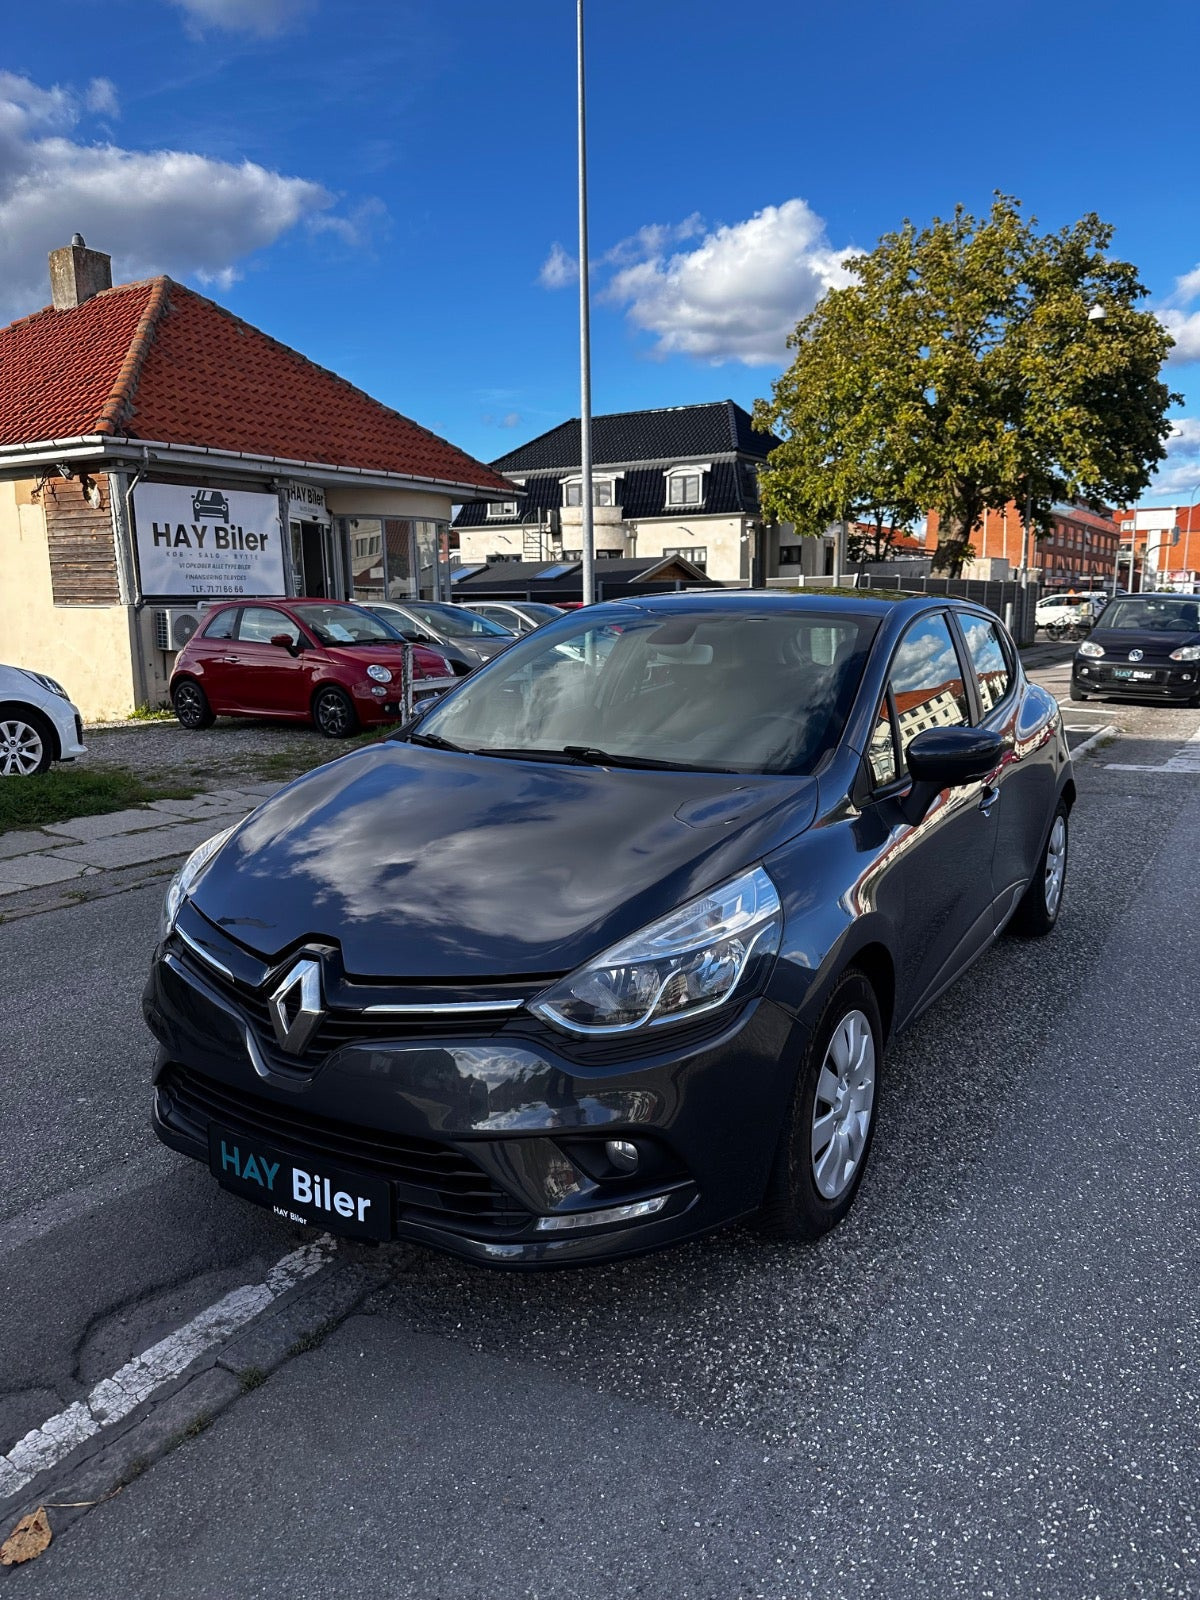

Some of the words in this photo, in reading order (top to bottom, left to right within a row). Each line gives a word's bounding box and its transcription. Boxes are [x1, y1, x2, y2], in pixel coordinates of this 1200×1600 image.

[291, 486, 306, 502] HAY
[307, 488, 323, 506] Biler
[152, 522, 208, 549] HAY
[214, 524, 269, 551] Biler
[191, 585, 206, 593] TLF.
[207, 585, 214, 593] 71
[215, 585, 222, 593] 71
[1133, 671, 1152, 679] Biler
[221, 1140, 280, 1191] HAY
[292, 1167, 371, 1222] Biler
[273, 1205, 288, 1217] HAY
[290, 1212, 307, 1225] Biler
